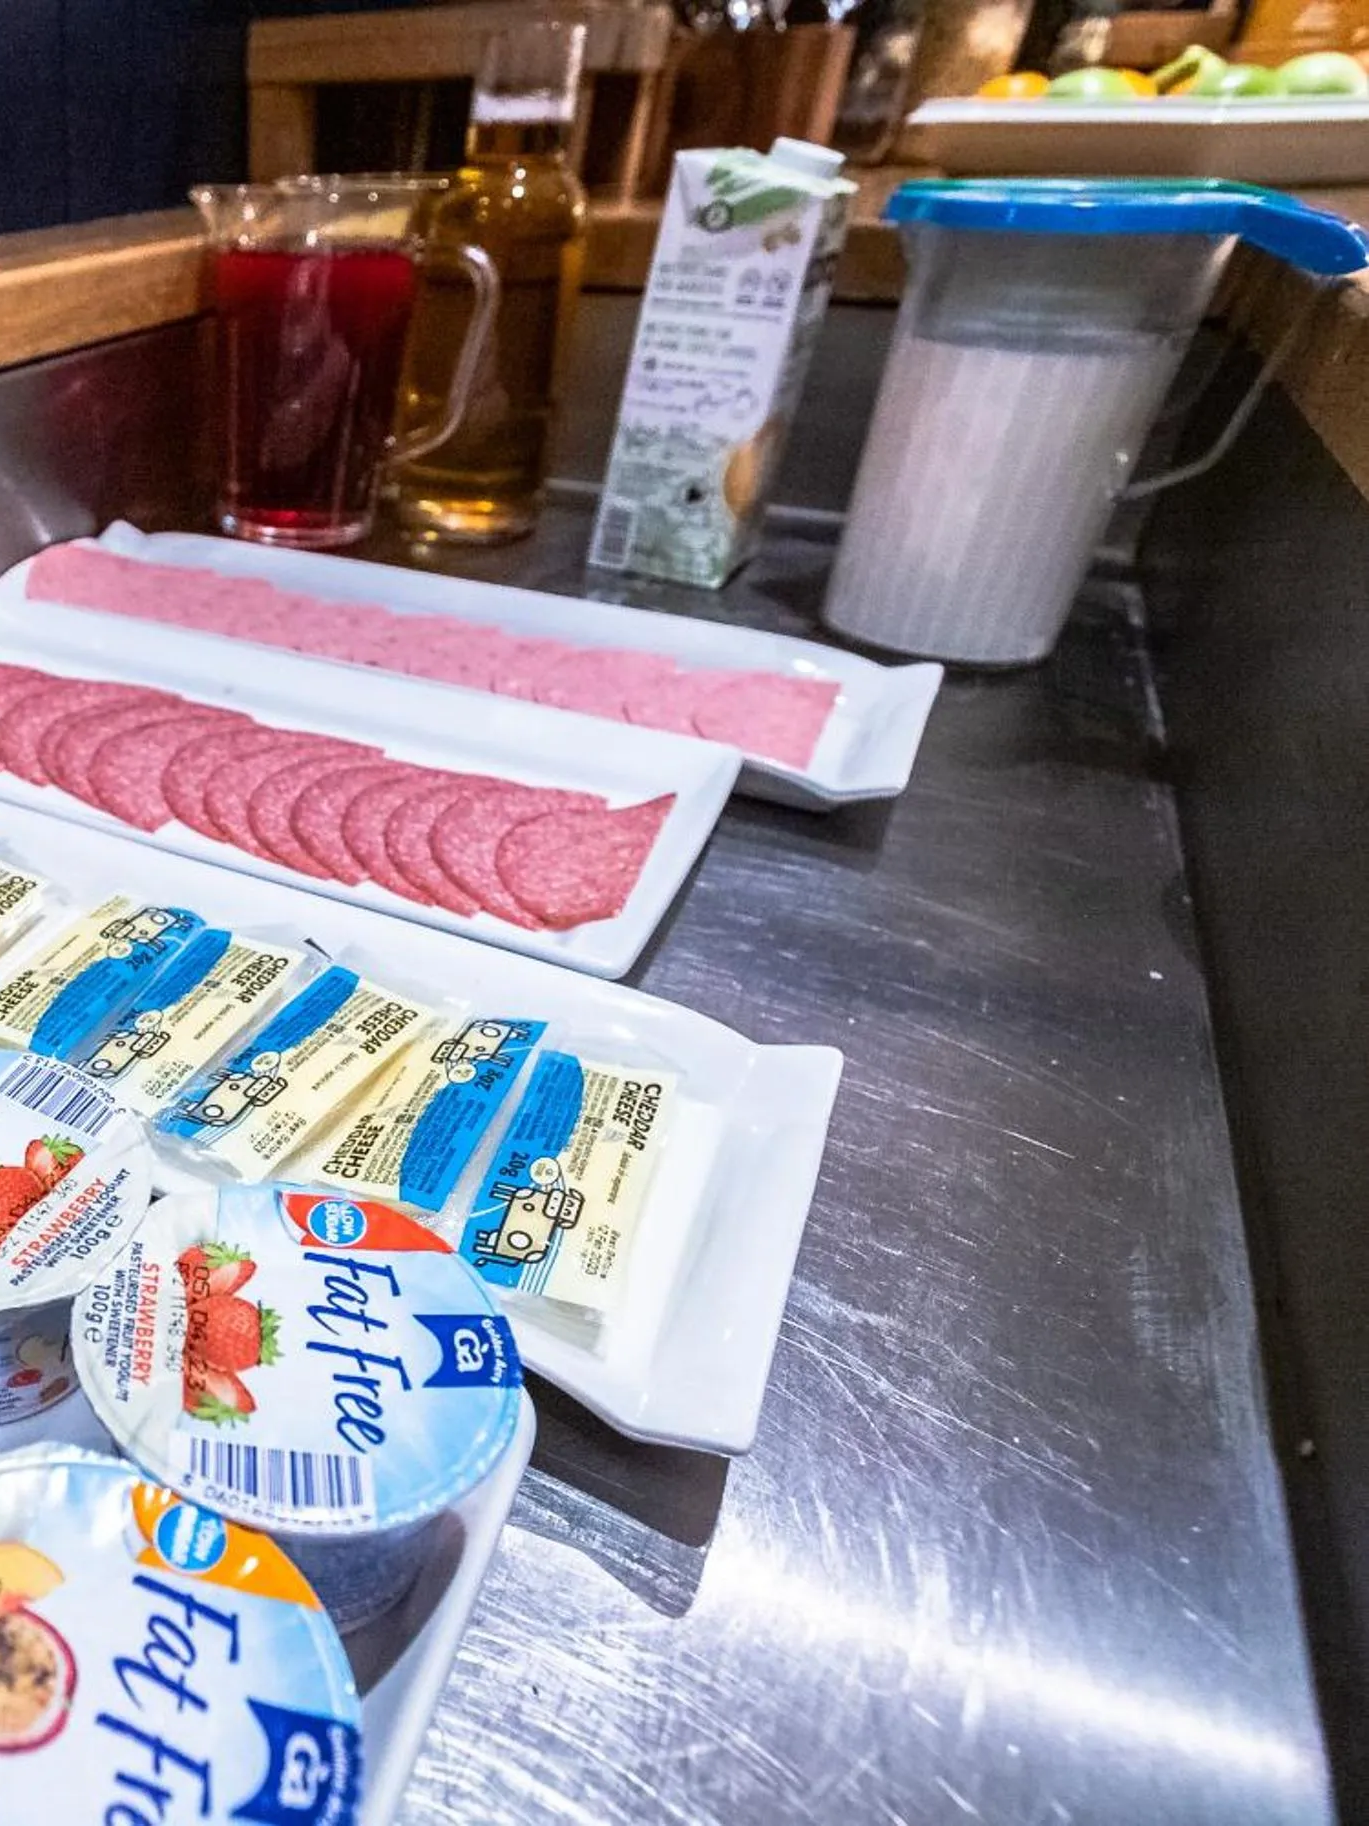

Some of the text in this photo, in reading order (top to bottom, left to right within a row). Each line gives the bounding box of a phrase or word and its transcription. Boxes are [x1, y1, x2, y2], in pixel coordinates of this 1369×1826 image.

[231, 953, 274, 987] CHEESE
[235, 957, 289, 1004] CHEDDAR
[355, 1001, 402, 1035] CHEESE
[359, 1008, 418, 1055] CHEDDAR
[613, 1080, 642, 1127] CHEESE
[628, 1083, 662, 1151] CHEDDAR
[322, 1113, 376, 1175] CHEDDAR
[341, 1123, 385, 1179] CHEESE
[500, 1152, 529, 1178] 20g
[9, 1230, 73, 1287] PASTEURISED
[68, 1205, 97, 1232] FRUIT
[11, 1177, 108, 1268] STRAWBERRY
[44, 1194, 124, 1269] WITH SWEETENER
[69, 1228, 112, 1260] 100g
[89, 1284, 112, 1326] 100g
[125, 1240, 144, 1315] PASTEURISED
[104, 1269, 127, 1368] WITH SWEETENER
[121, 1317, 136, 1352] FRUIT
[130, 1261, 160, 1387] STRAWBERRY
[304, 1251, 413, 1455] Fat Free
[113, 1573, 242, 1717] Fat
